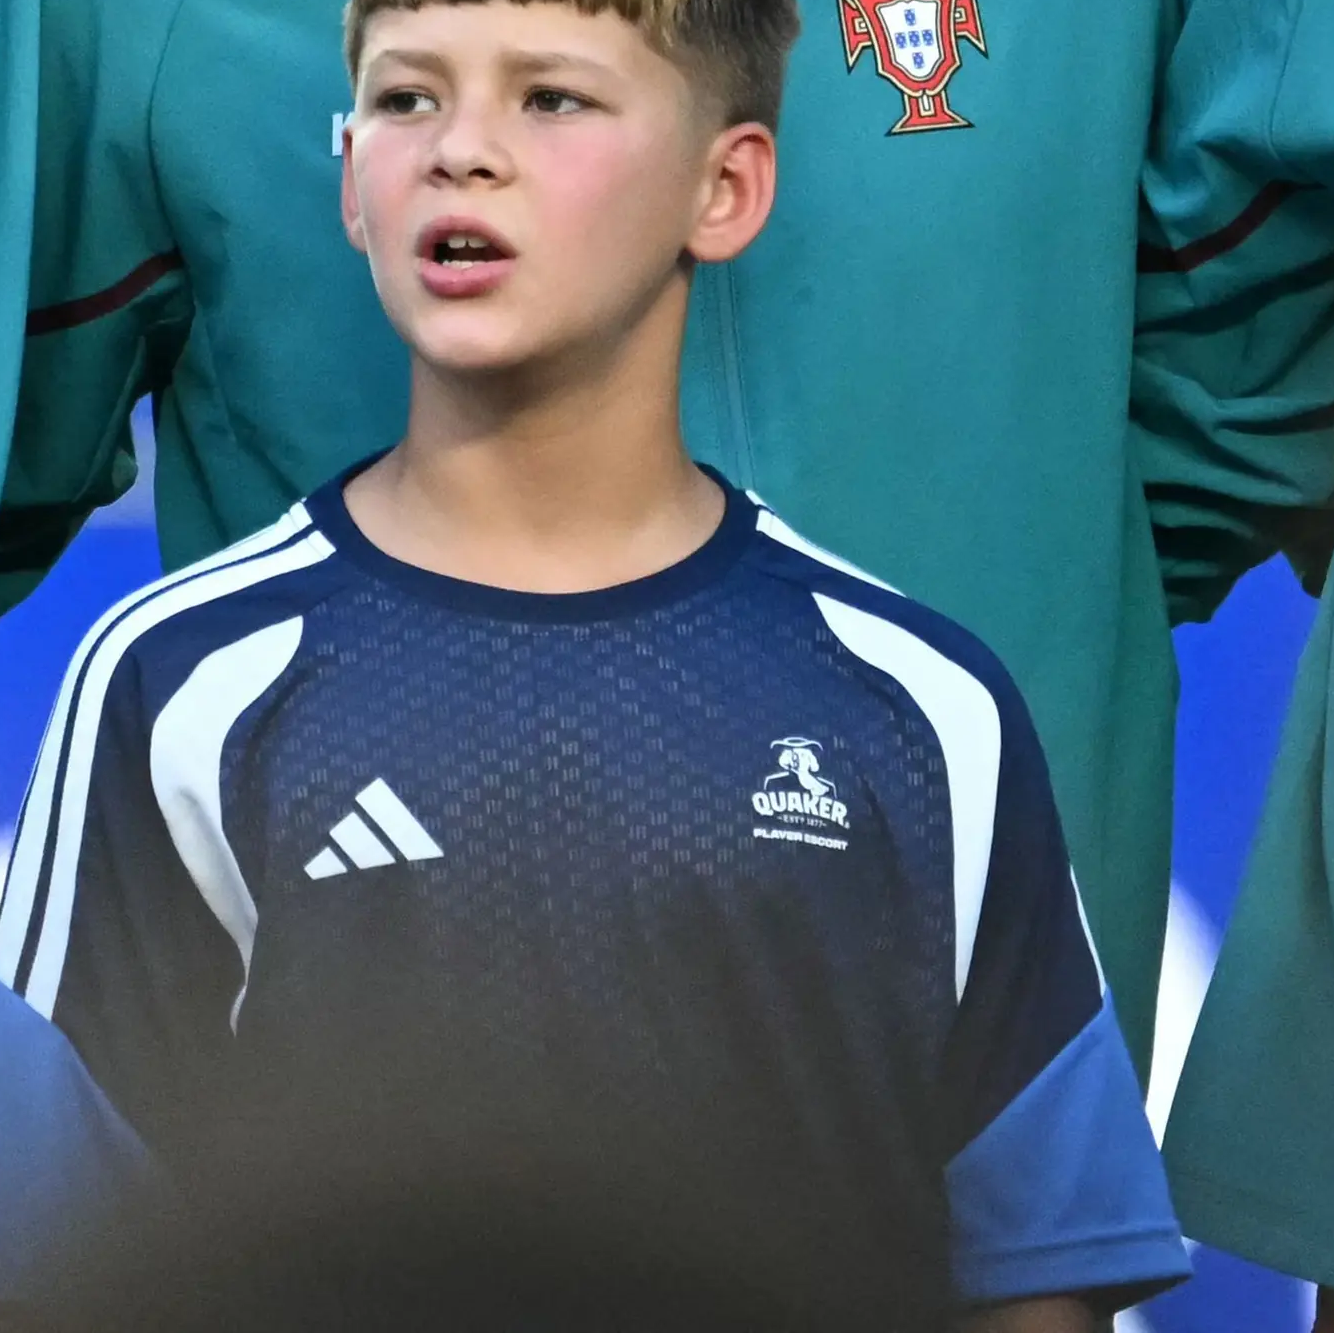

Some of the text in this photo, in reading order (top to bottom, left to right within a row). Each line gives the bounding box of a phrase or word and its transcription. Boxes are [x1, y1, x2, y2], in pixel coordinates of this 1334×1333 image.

[751, 791, 848, 827] QUAKER
[752, 828, 849, 851] PLAYER ESCORT
